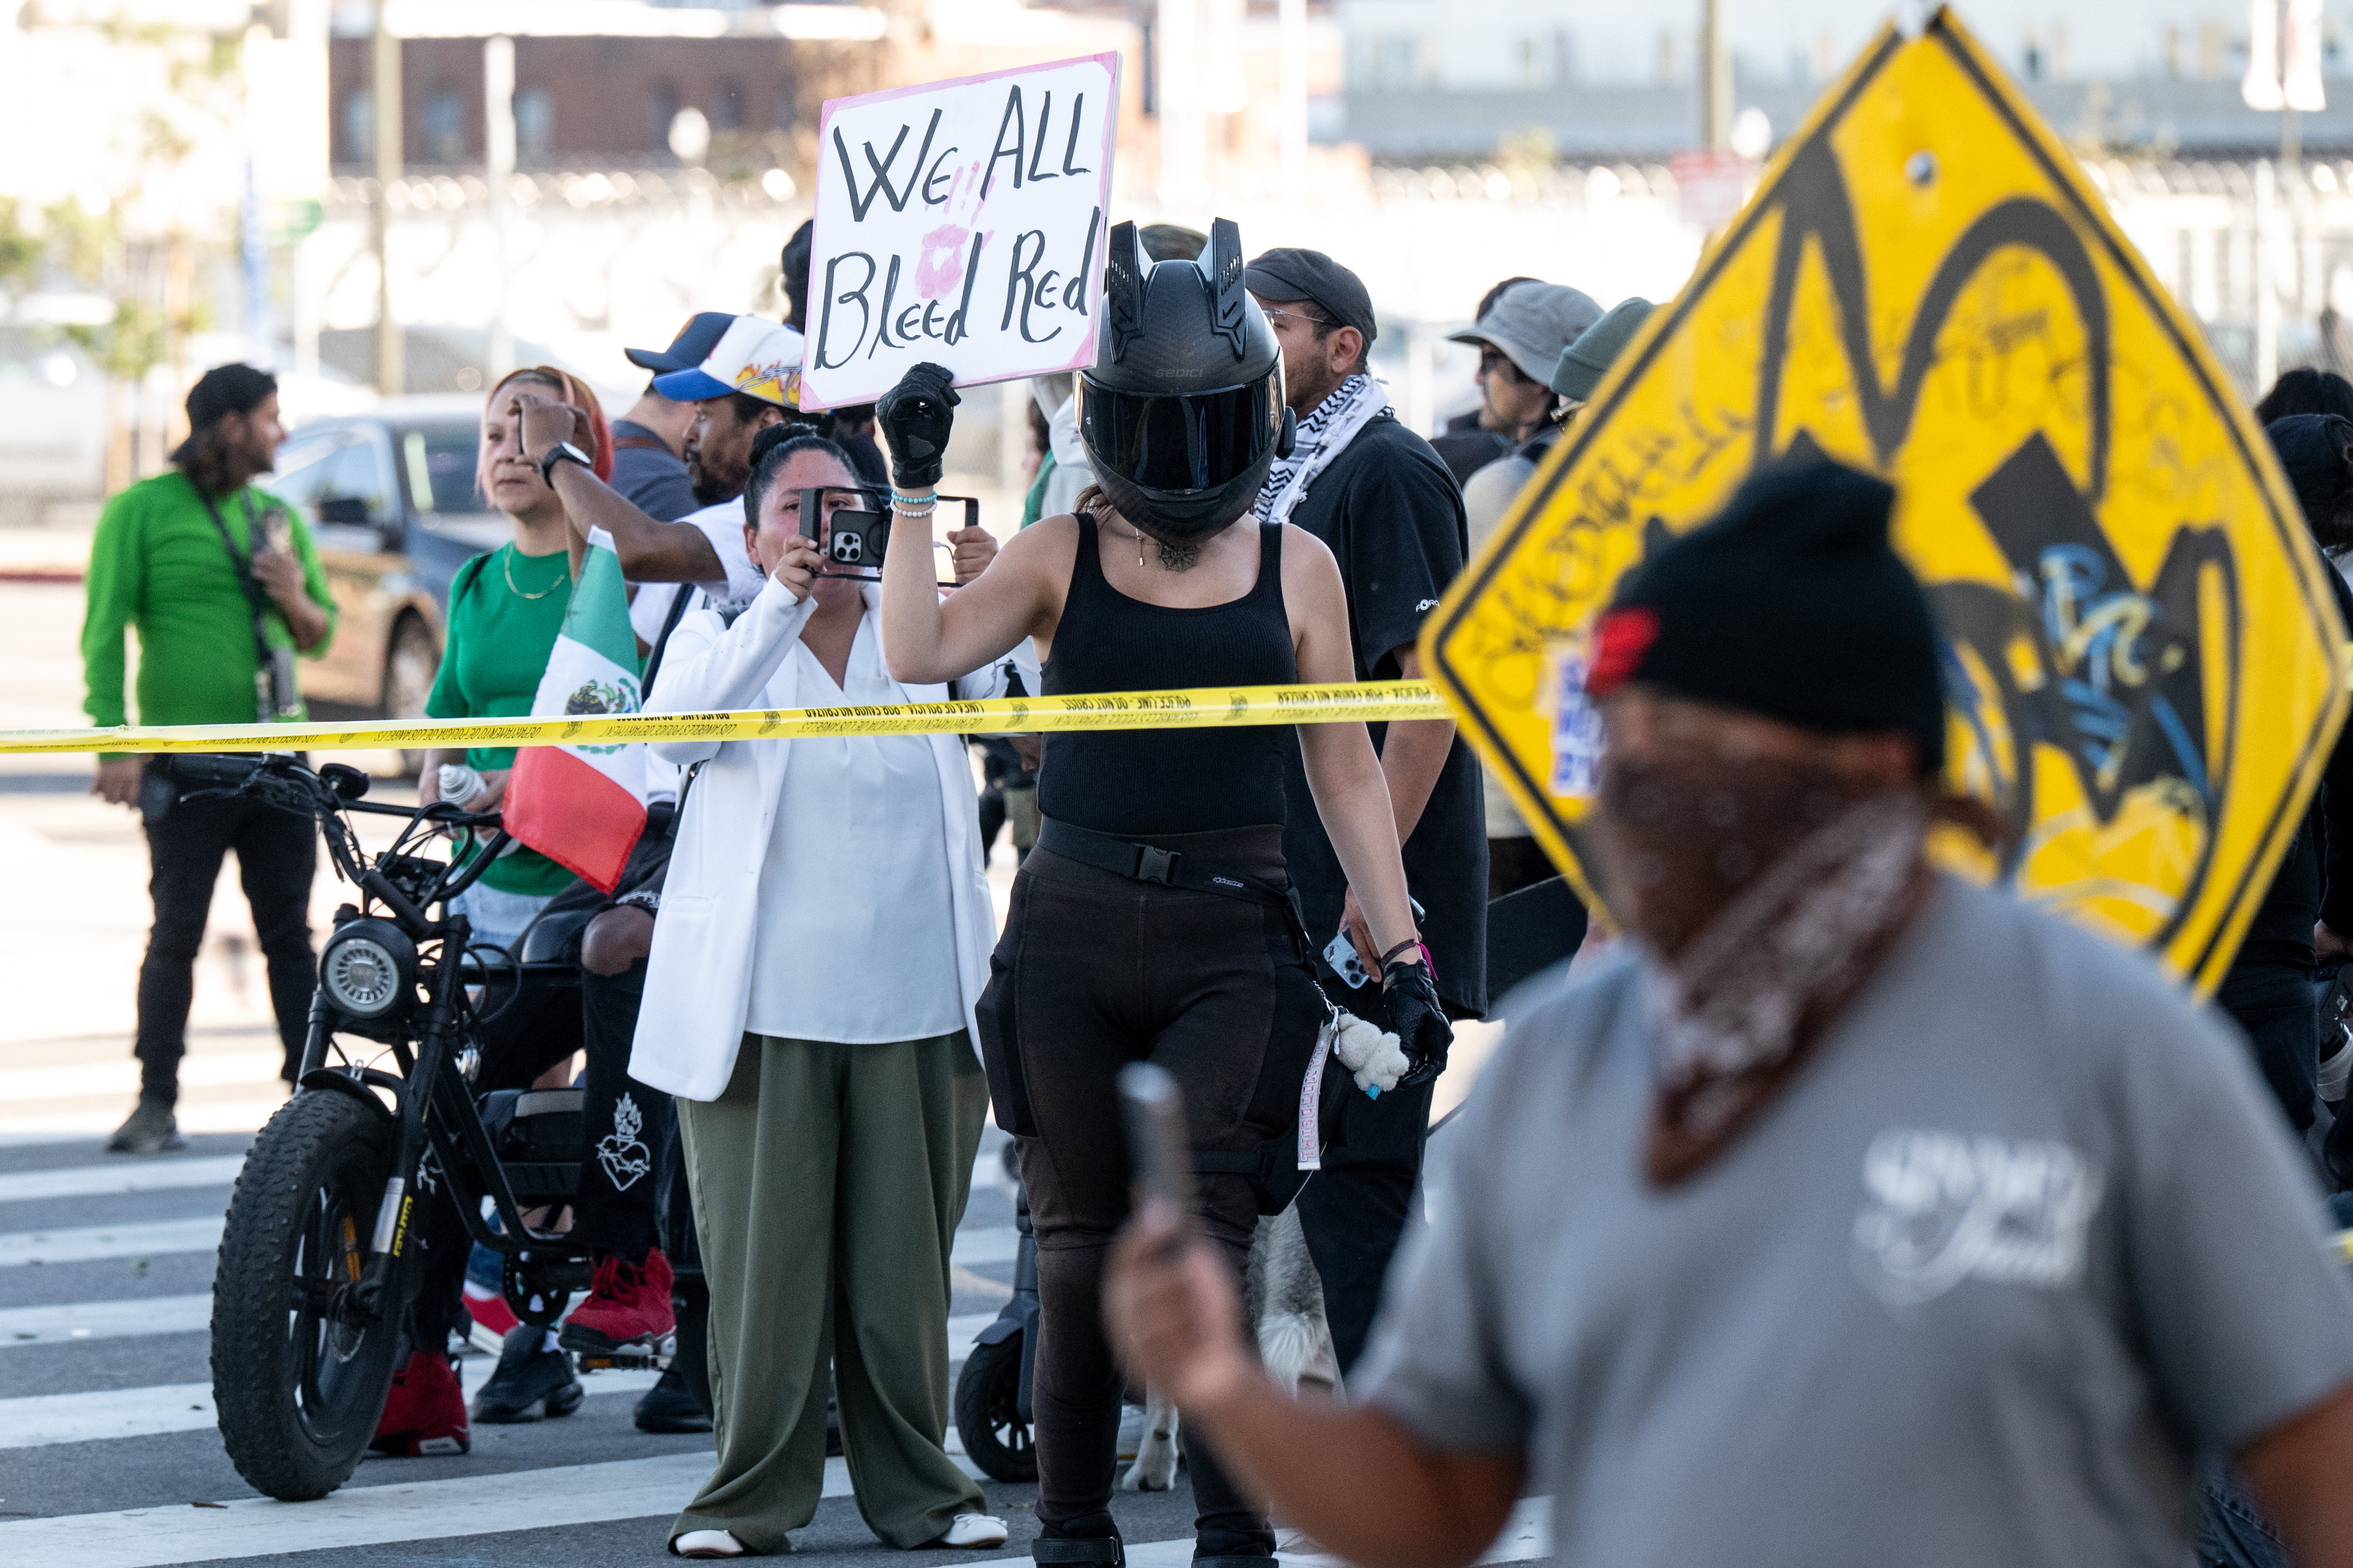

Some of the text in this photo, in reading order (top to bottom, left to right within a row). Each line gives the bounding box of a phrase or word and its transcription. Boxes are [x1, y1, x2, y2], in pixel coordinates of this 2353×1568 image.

[980, 84, 1091, 201] ALL
[814, 206, 1100, 371] Bleed Red
[1061, 699, 1094, 710] CROSS
[1093, 699, 1114, 710] NOT
[1112, 698, 1128, 709] DO
[1135, 697, 1156, 709] LINE
[1155, 696, 1191, 709] POLICE
[804, 708, 839, 718] CRUZAR
[839, 707, 853, 717] NO
[854, 706, 882, 716] FAVOR
[882, 706, 901, 716] POR
[906, 705, 943, 715] POLICIA
[944, 704, 956, 714] DE
[956, 703, 984, 714] LINEA
[598, 724, 738, 737] LOS ANGELES POLICE DEPARTMENT
[797, 722, 841, 733] ANGELES
[836, 722, 857, 732] LOS
[866, 720, 904, 731] POLICIA
[374, 727, 542, 741] DEPARTAMENTO DE POLICIA DE LOS ANGELES
